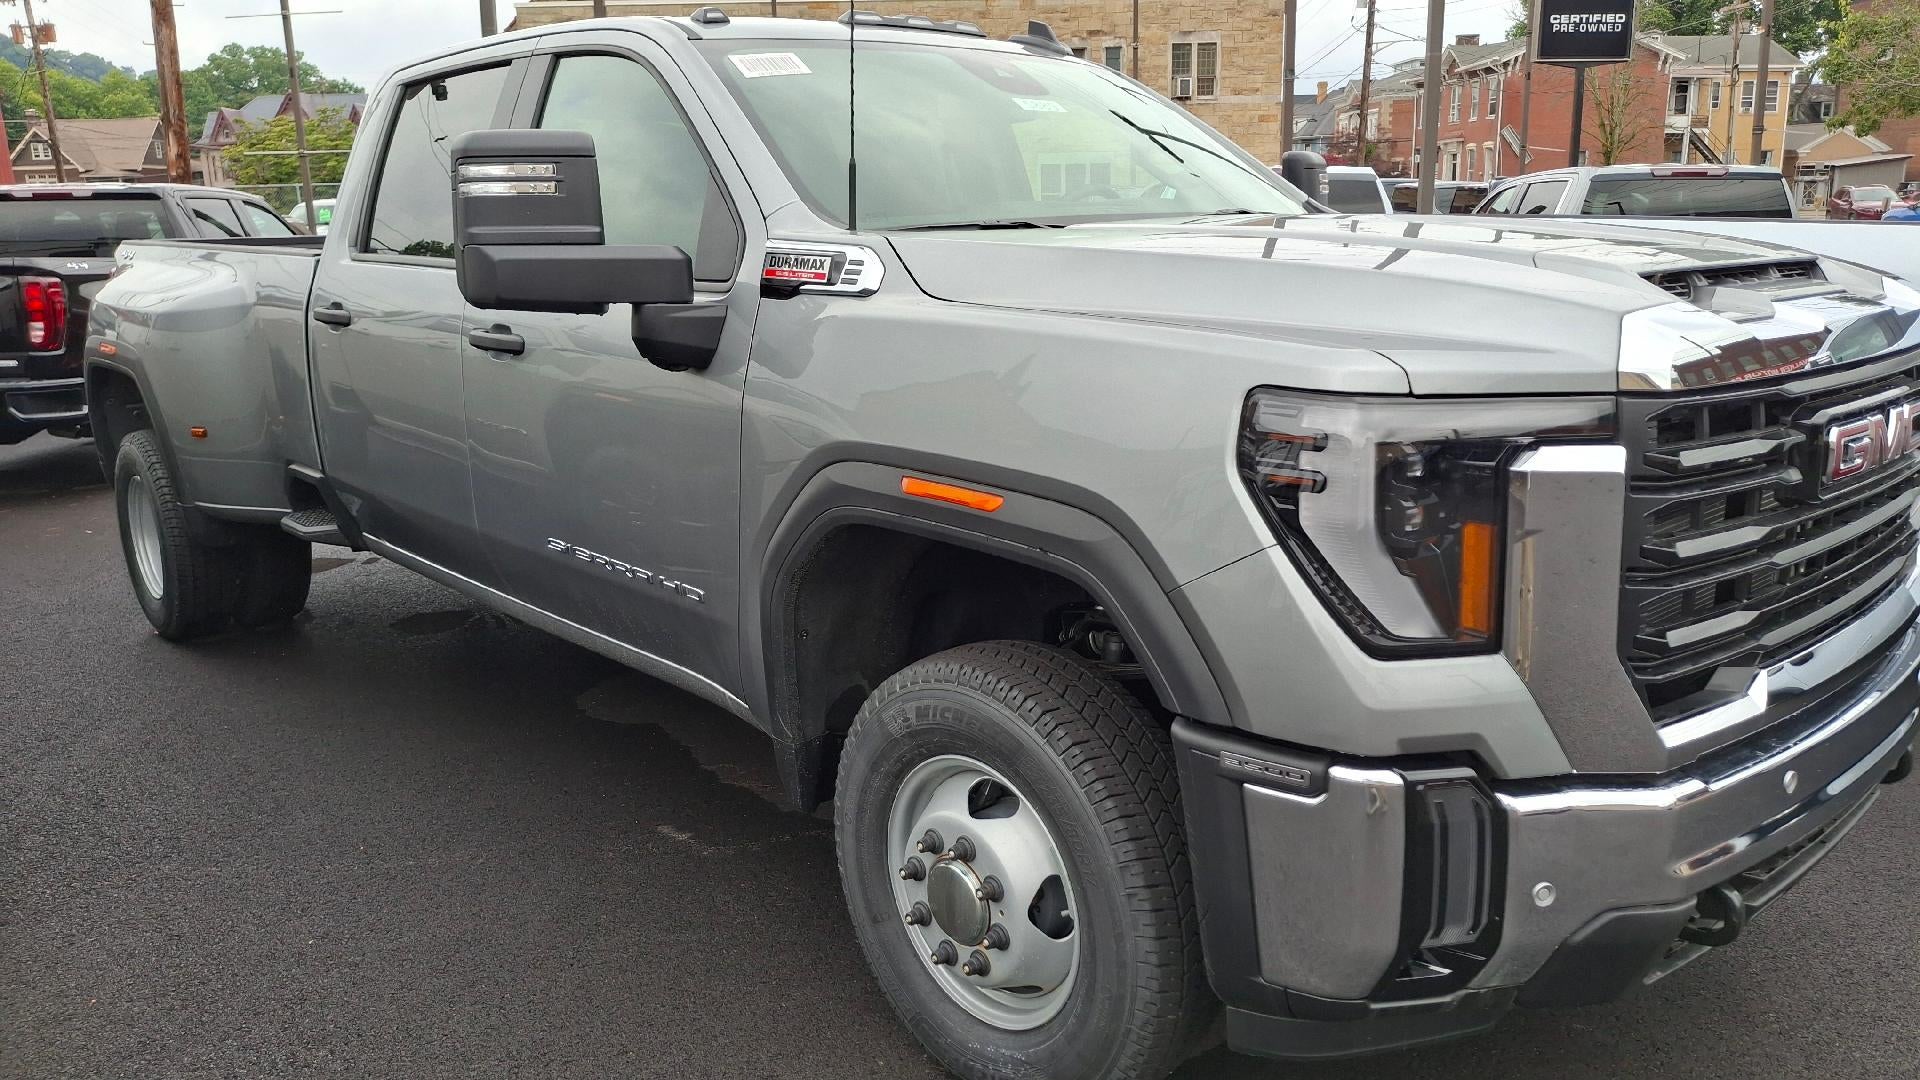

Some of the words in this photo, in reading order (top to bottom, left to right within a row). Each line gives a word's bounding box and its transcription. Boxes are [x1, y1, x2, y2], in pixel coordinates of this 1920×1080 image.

[1549, 13, 1626, 24] CERTIFIED
[1552, 23, 1622, 33] PRE-OWNED
[768, 254, 827, 271] DURAMAX
[547, 537, 654, 585] SIERRA
[658, 574, 706, 604] HD
